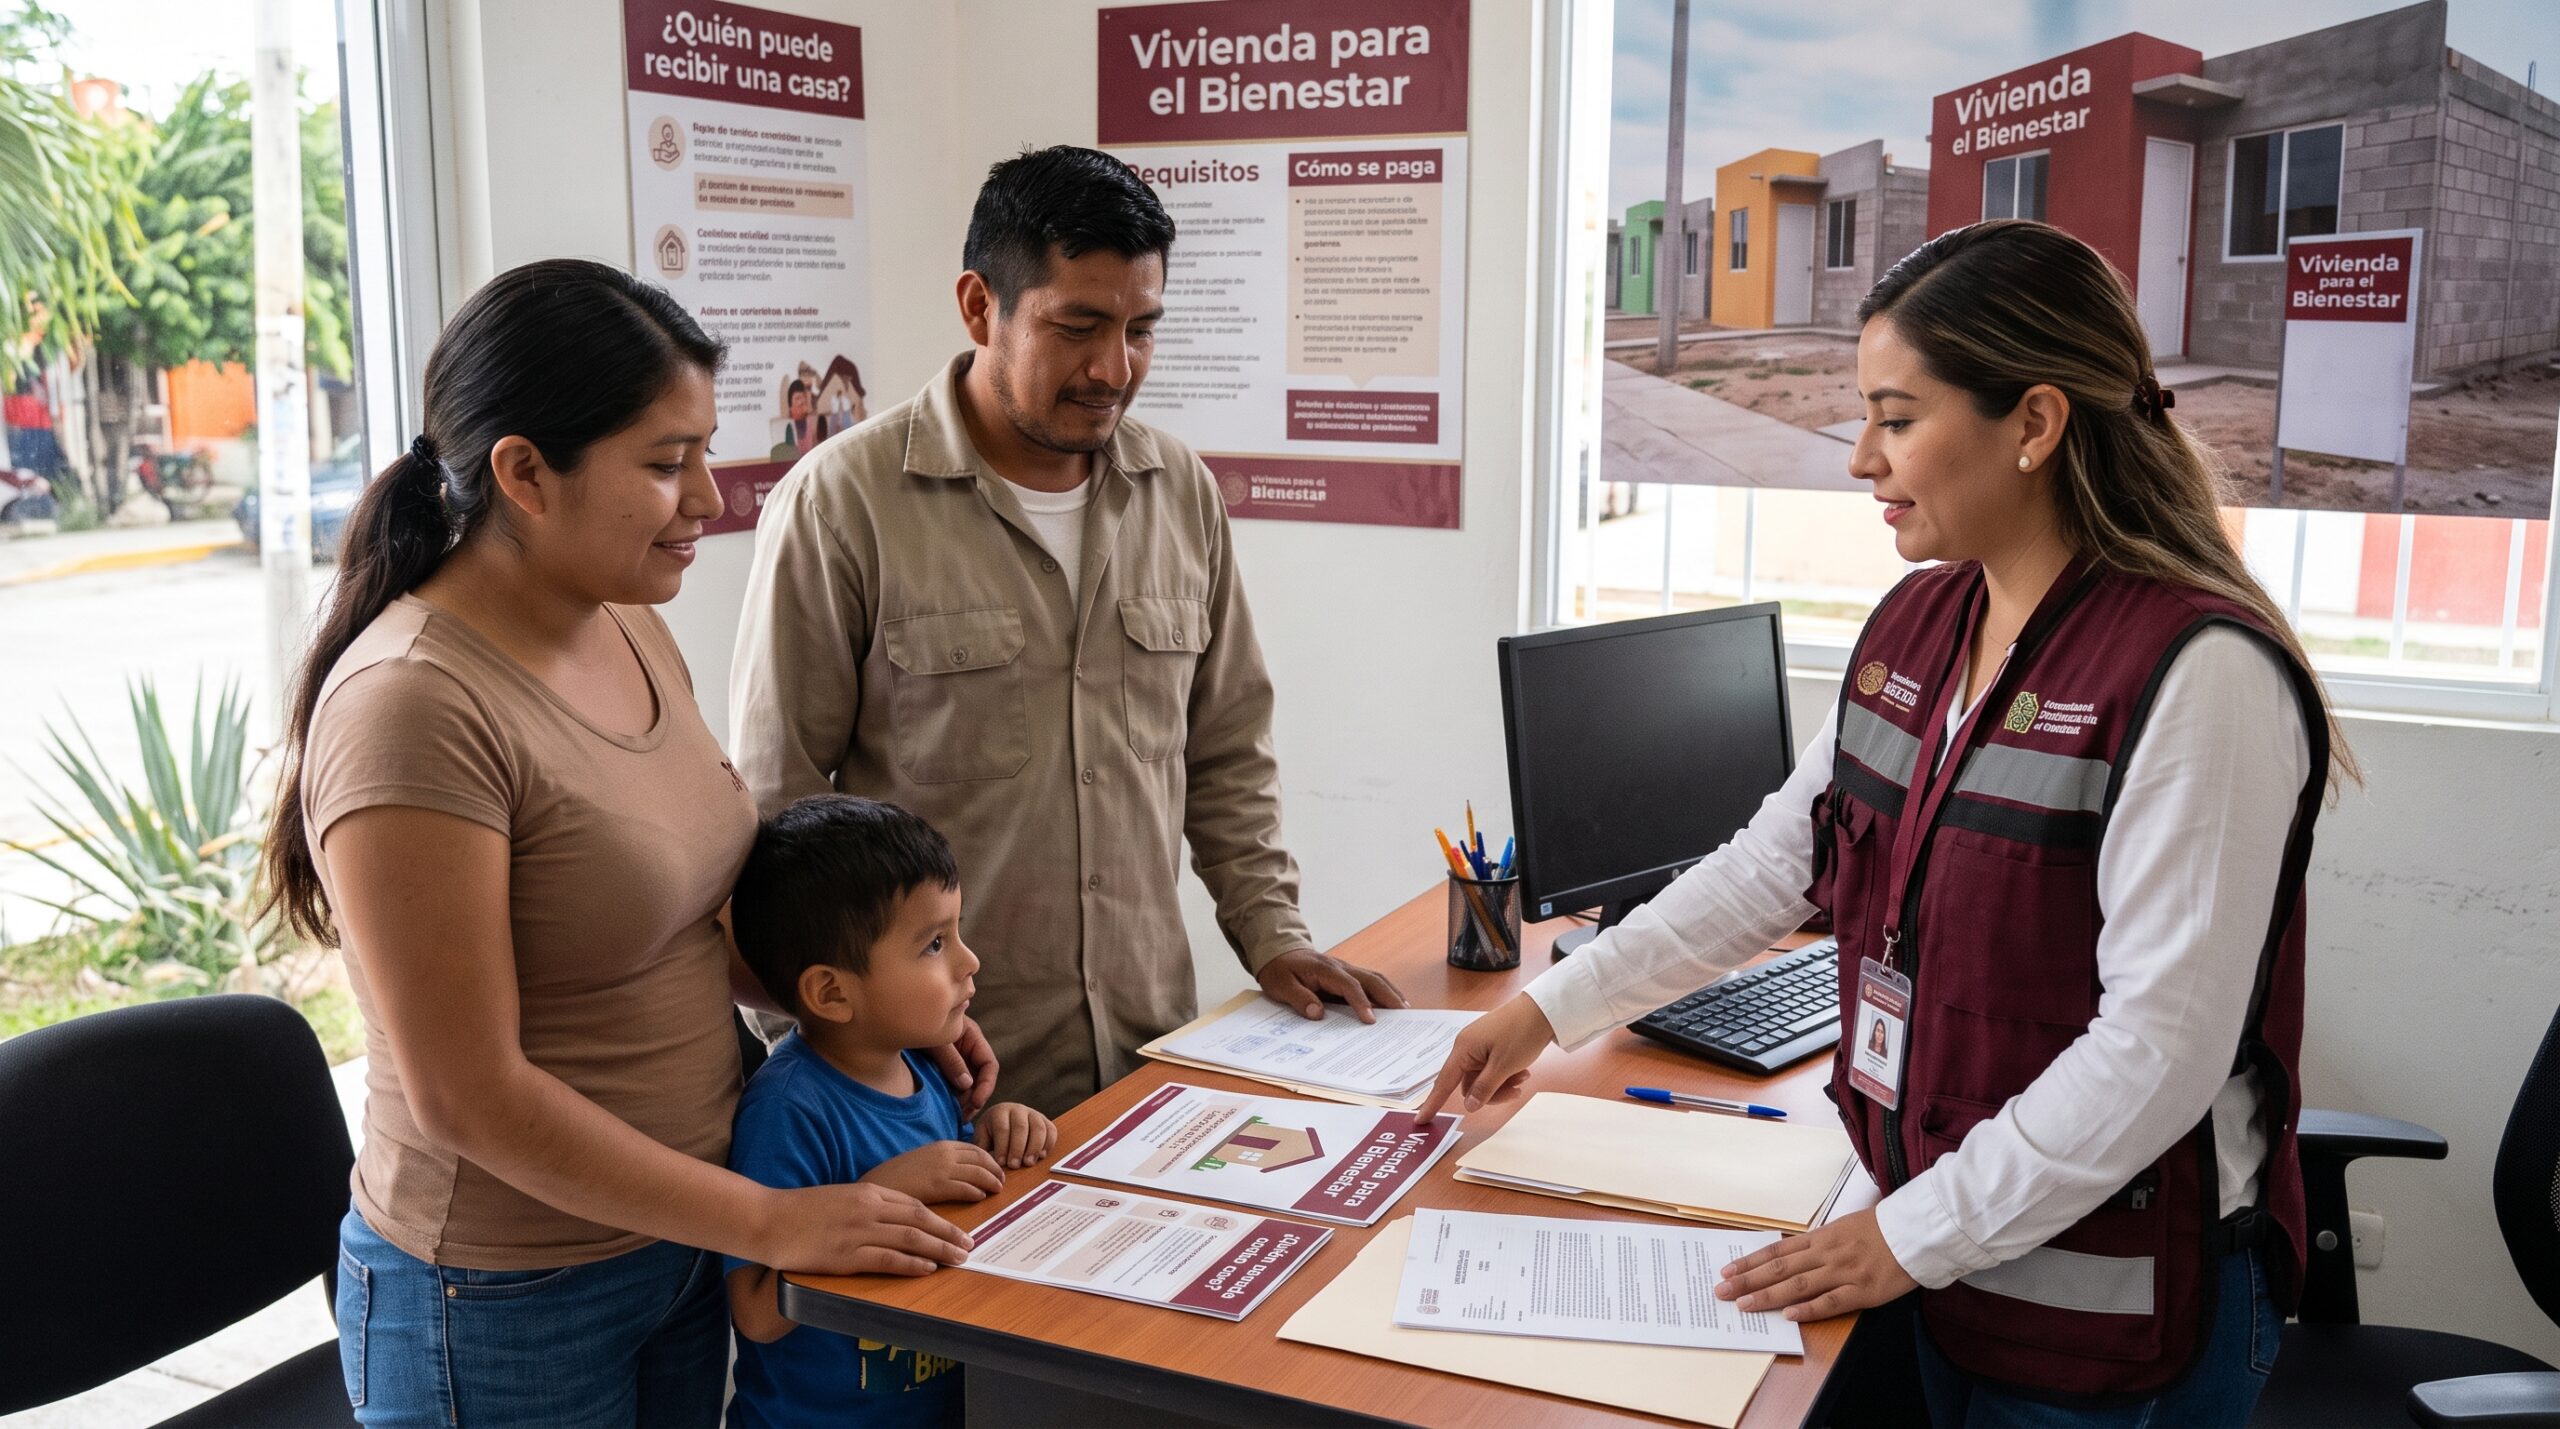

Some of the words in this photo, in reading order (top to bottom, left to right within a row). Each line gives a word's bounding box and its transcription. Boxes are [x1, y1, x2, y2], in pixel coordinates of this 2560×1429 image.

[662, 10, 752, 50] ¿Quién
[759, 30, 833, 63] puede
[1130, 23, 1316, 69] Vivienda
[1330, 24, 1430, 68] para
[644, 50, 729, 86] recibir
[736, 65, 782, 94] una
[788, 75, 851, 103] casa?
[1148, 77, 1185, 115] el
[1199, 72, 1411, 114] Bienestar
[1955, 64, 2091, 125] Vivienda
[1952, 129, 1970, 156] el
[1976, 106, 2091, 151] Bienestar
[1295, 159, 1353, 178] Cómo
[1357, 161, 1380, 176] se
[1385, 160, 1436, 179] paga
[2299, 253, 2399, 273] Vivienda
[2319, 276, 2355, 290] para
[2359, 274, 2374, 288] el
[2293, 289, 2401, 308] Bienestar
[1372, 1132, 1430, 1179] Vivienda
[1375, 1132, 1396, 1144] el
[1323, 1145, 1389, 1198] Bienestar
[1344, 1180, 1380, 1207] para
